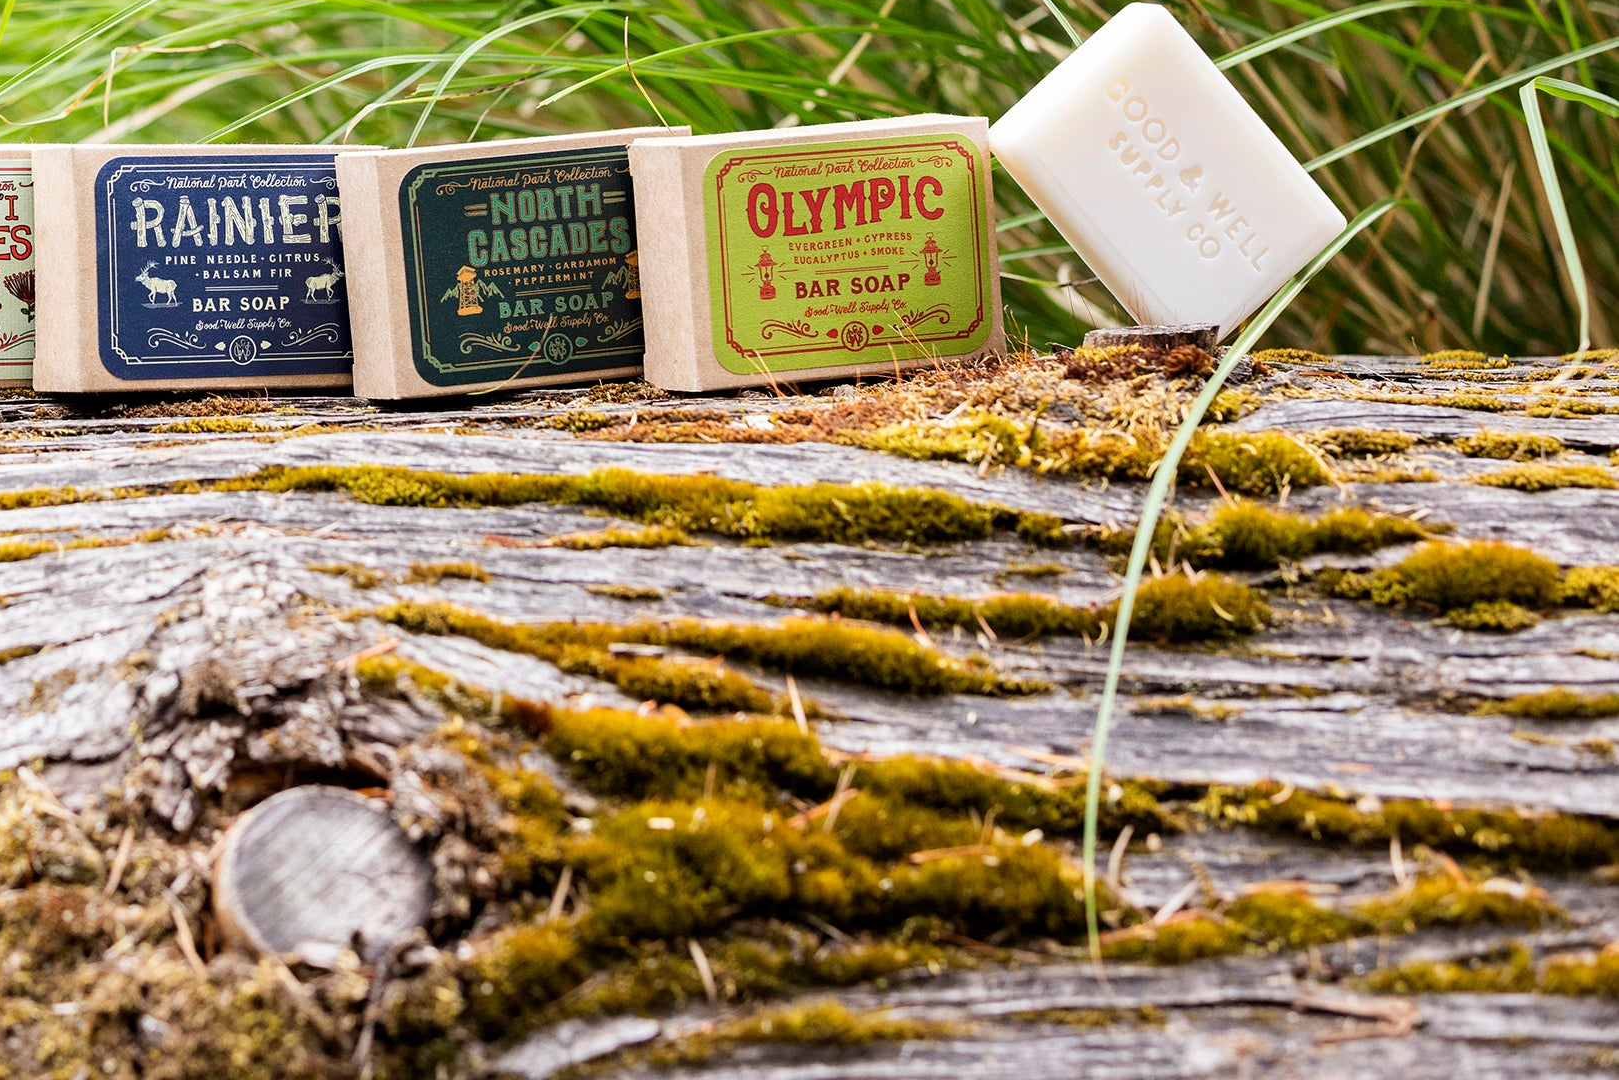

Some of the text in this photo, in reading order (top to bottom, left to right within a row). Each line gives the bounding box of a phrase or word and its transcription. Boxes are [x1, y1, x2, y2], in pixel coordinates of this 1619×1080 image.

[774, 156, 915, 179] National Park Collection
[1106, 77, 1270, 273] GOOD & WELL
[166, 174, 307, 190] National Park Collection
[469, 167, 612, 191] National Park Collection
[489, 183, 602, 225] NORTH
[1107, 130, 1221, 260] SUPPLY CO
[745, 175, 945, 238] OLYMPIC
[131, 193, 343, 248] RAINIER
[467, 216, 631, 268] CASCADES
[789, 232, 912, 251] EVERGREEN CYPRESS
[165, 253, 320, 265] PINE NEEDLE CITRUS
[793, 247, 905, 264] EUCALYPTUS SMOKE
[203, 268, 292, 279] BALSAM FIR
[484, 257, 617, 277] ROSEMARY CARDAMOM
[515, 272, 595, 286] PEPPERMINT
[795, 273, 911, 299] BAR SOAP
[193, 296, 290, 312] BAR SOAP
[499, 292, 614, 319] BAR SOAP
[859, 301, 891, 314] Supply
[892, 299, 907, 311] Co.
[247, 317, 276, 330] Supply
[278, 317, 292, 328] Co.
[559, 314, 593, 328] Supply
[593, 312, 609, 323] Co.
